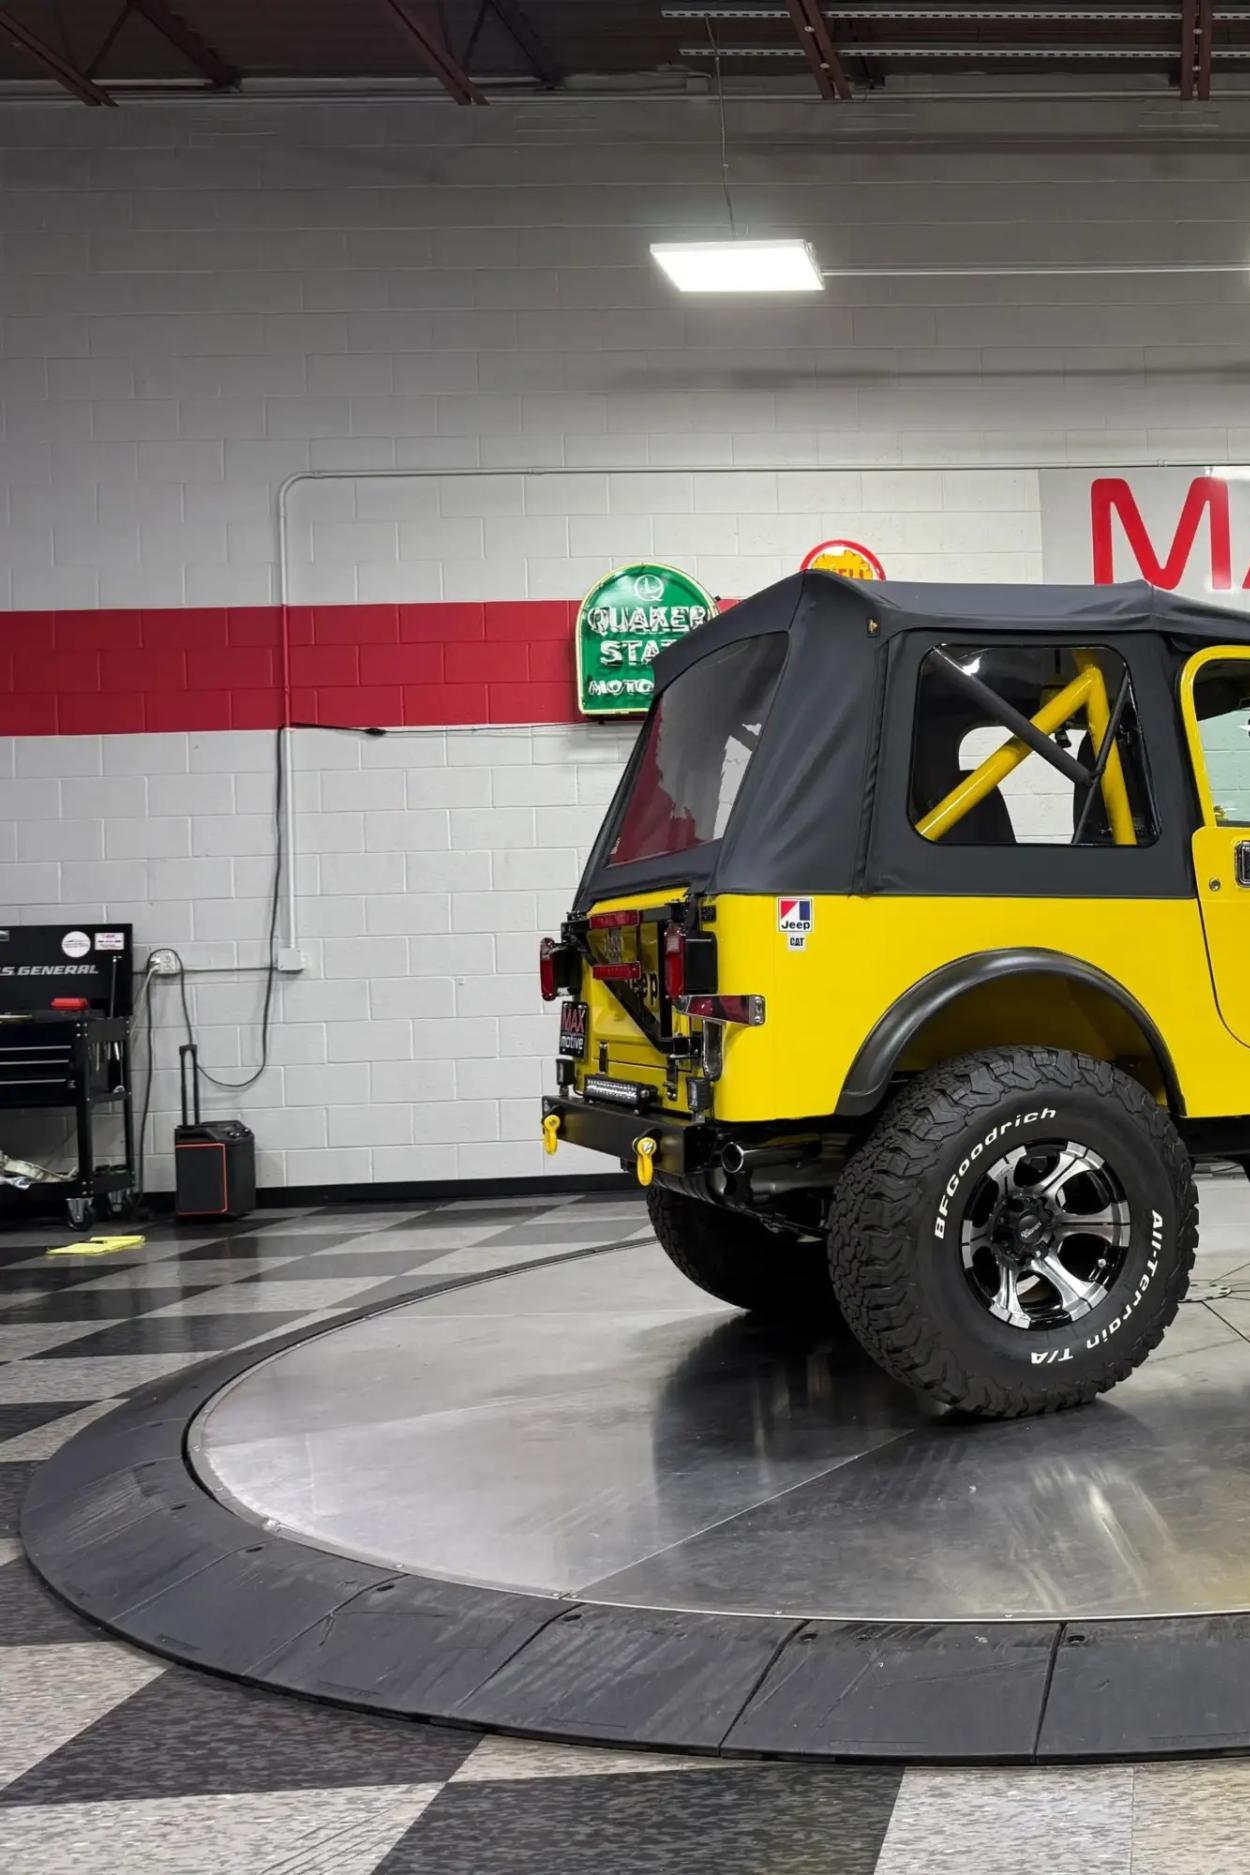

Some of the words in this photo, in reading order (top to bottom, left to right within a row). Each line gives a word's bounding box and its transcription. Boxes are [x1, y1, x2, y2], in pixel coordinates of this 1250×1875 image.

[587, 605, 706, 636] QUAKER
[588, 679, 654, 695] MOTO
[781, 920, 810, 930] Jeep
[790, 937, 804, 946] CAT
[17, 965, 99, 976] GENERAL
[561, 1008, 585, 1032] MAX
[934, 1108, 1056, 1239] BFGoodrich
[1086, 1210, 1163, 1349] All-Terrain
[1031, 1348, 1073, 1364] T/A
